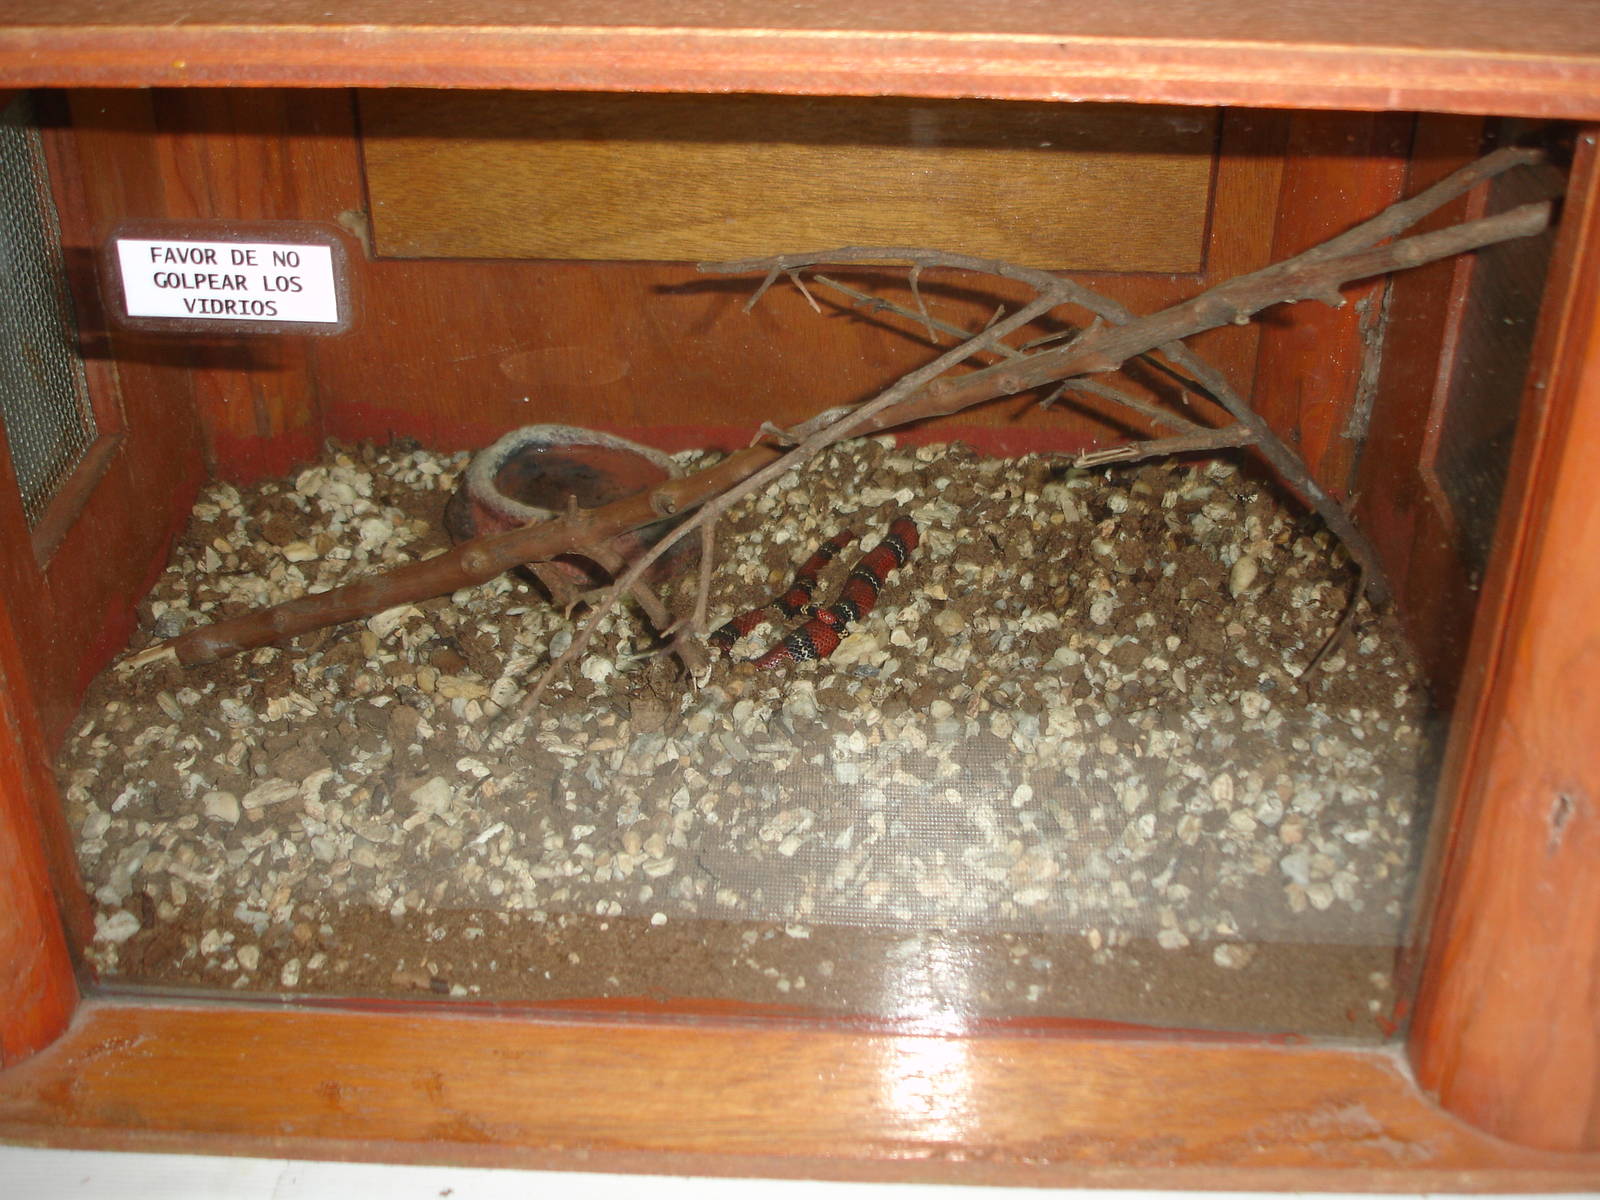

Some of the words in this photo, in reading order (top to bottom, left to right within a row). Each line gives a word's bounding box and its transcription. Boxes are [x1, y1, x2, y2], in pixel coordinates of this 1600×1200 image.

[150, 246, 217, 265] FAVOR
[230, 249, 258, 266] DE
[272, 250, 300, 268] NO
[153, 271, 248, 291] GOLPEAR
[263, 275, 303, 293] LOS
[183, 298, 278, 317] VIDRIOS
